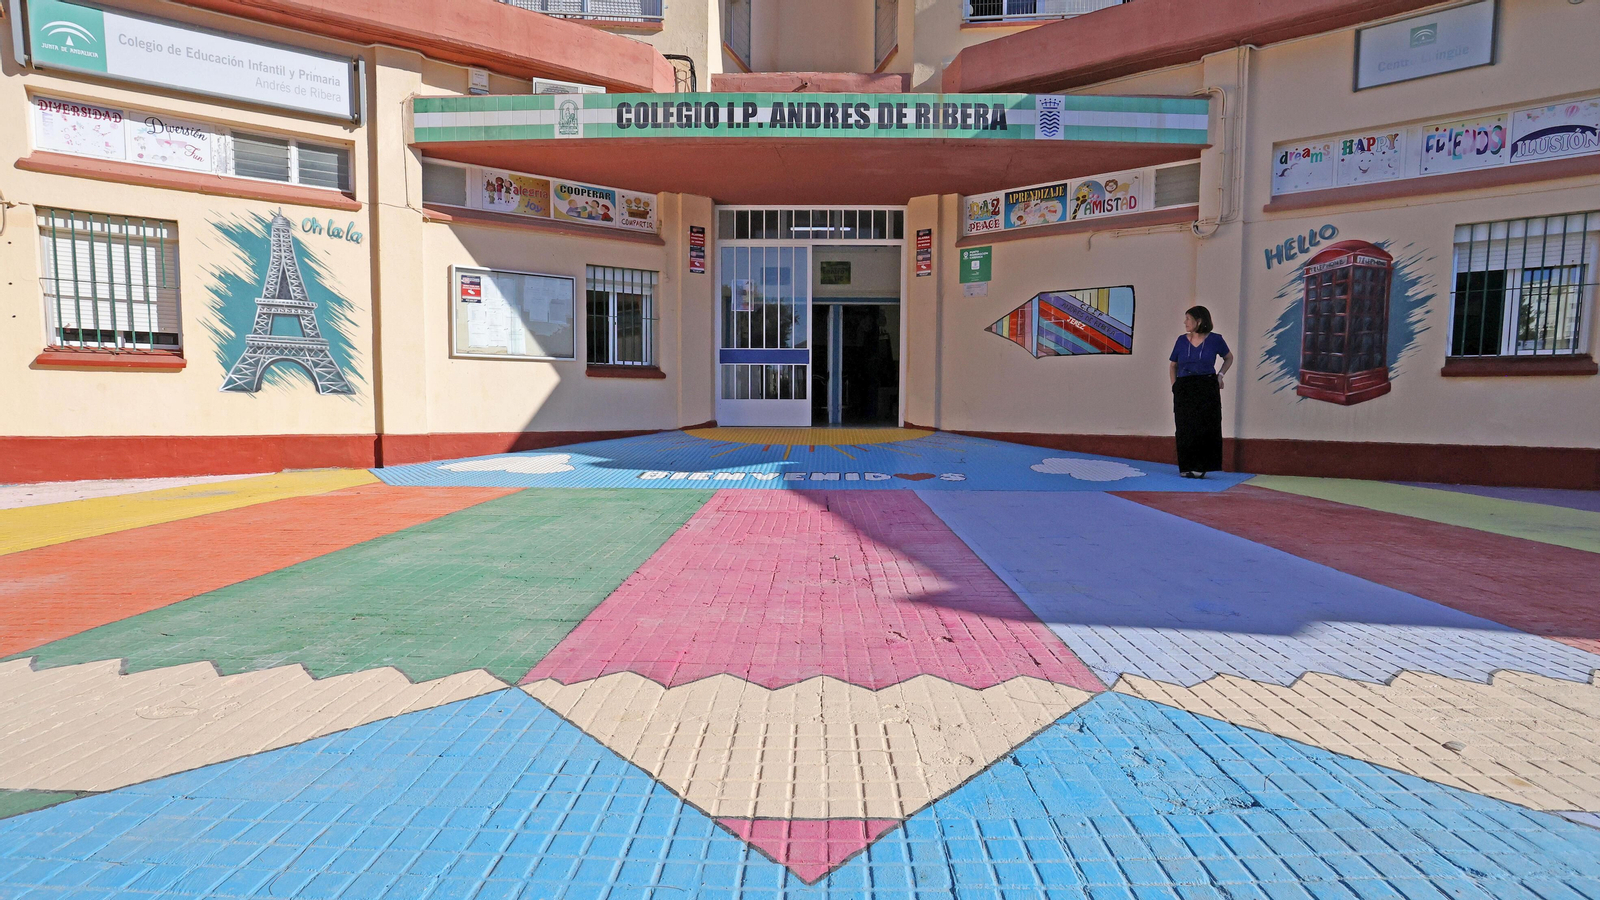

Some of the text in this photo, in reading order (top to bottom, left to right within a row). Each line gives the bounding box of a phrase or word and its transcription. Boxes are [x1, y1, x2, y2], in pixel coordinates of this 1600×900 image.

[41, 42, 59, 50] JUNTA
[119, 33, 341, 87] Colegio de Educación Infantil y Primaria
[1377, 57, 1416, 72] Centr
[255, 77, 342, 102] Andrés de Ribera
[37, 99, 123, 124] DIVERSIDAD
[616, 102, 1008, 131] COLEGIO I.P. ANDRES DE RIBERA
[144, 116, 208, 142] Diversión
[183, 144, 204, 163] Fun
[1342, 133, 1399, 155] HAPPY
[1515, 128, 1600, 158] ILUSIÓN
[1280, 144, 1330, 164] dreams
[560, 185, 611, 200] COOPERAR
[1007, 186, 1065, 204] APRENDIZAJE
[969, 198, 1000, 220] PAZ
[1084, 195, 1137, 215] AMISTAD
[302, 217, 363, 244] Oh la la
[621, 218, 654, 229] COMPARTIR
[968, 219, 1000, 232] PEACE
[1264, 224, 1338, 270] HELLO
[1067, 316, 1086, 330] JEREZ
